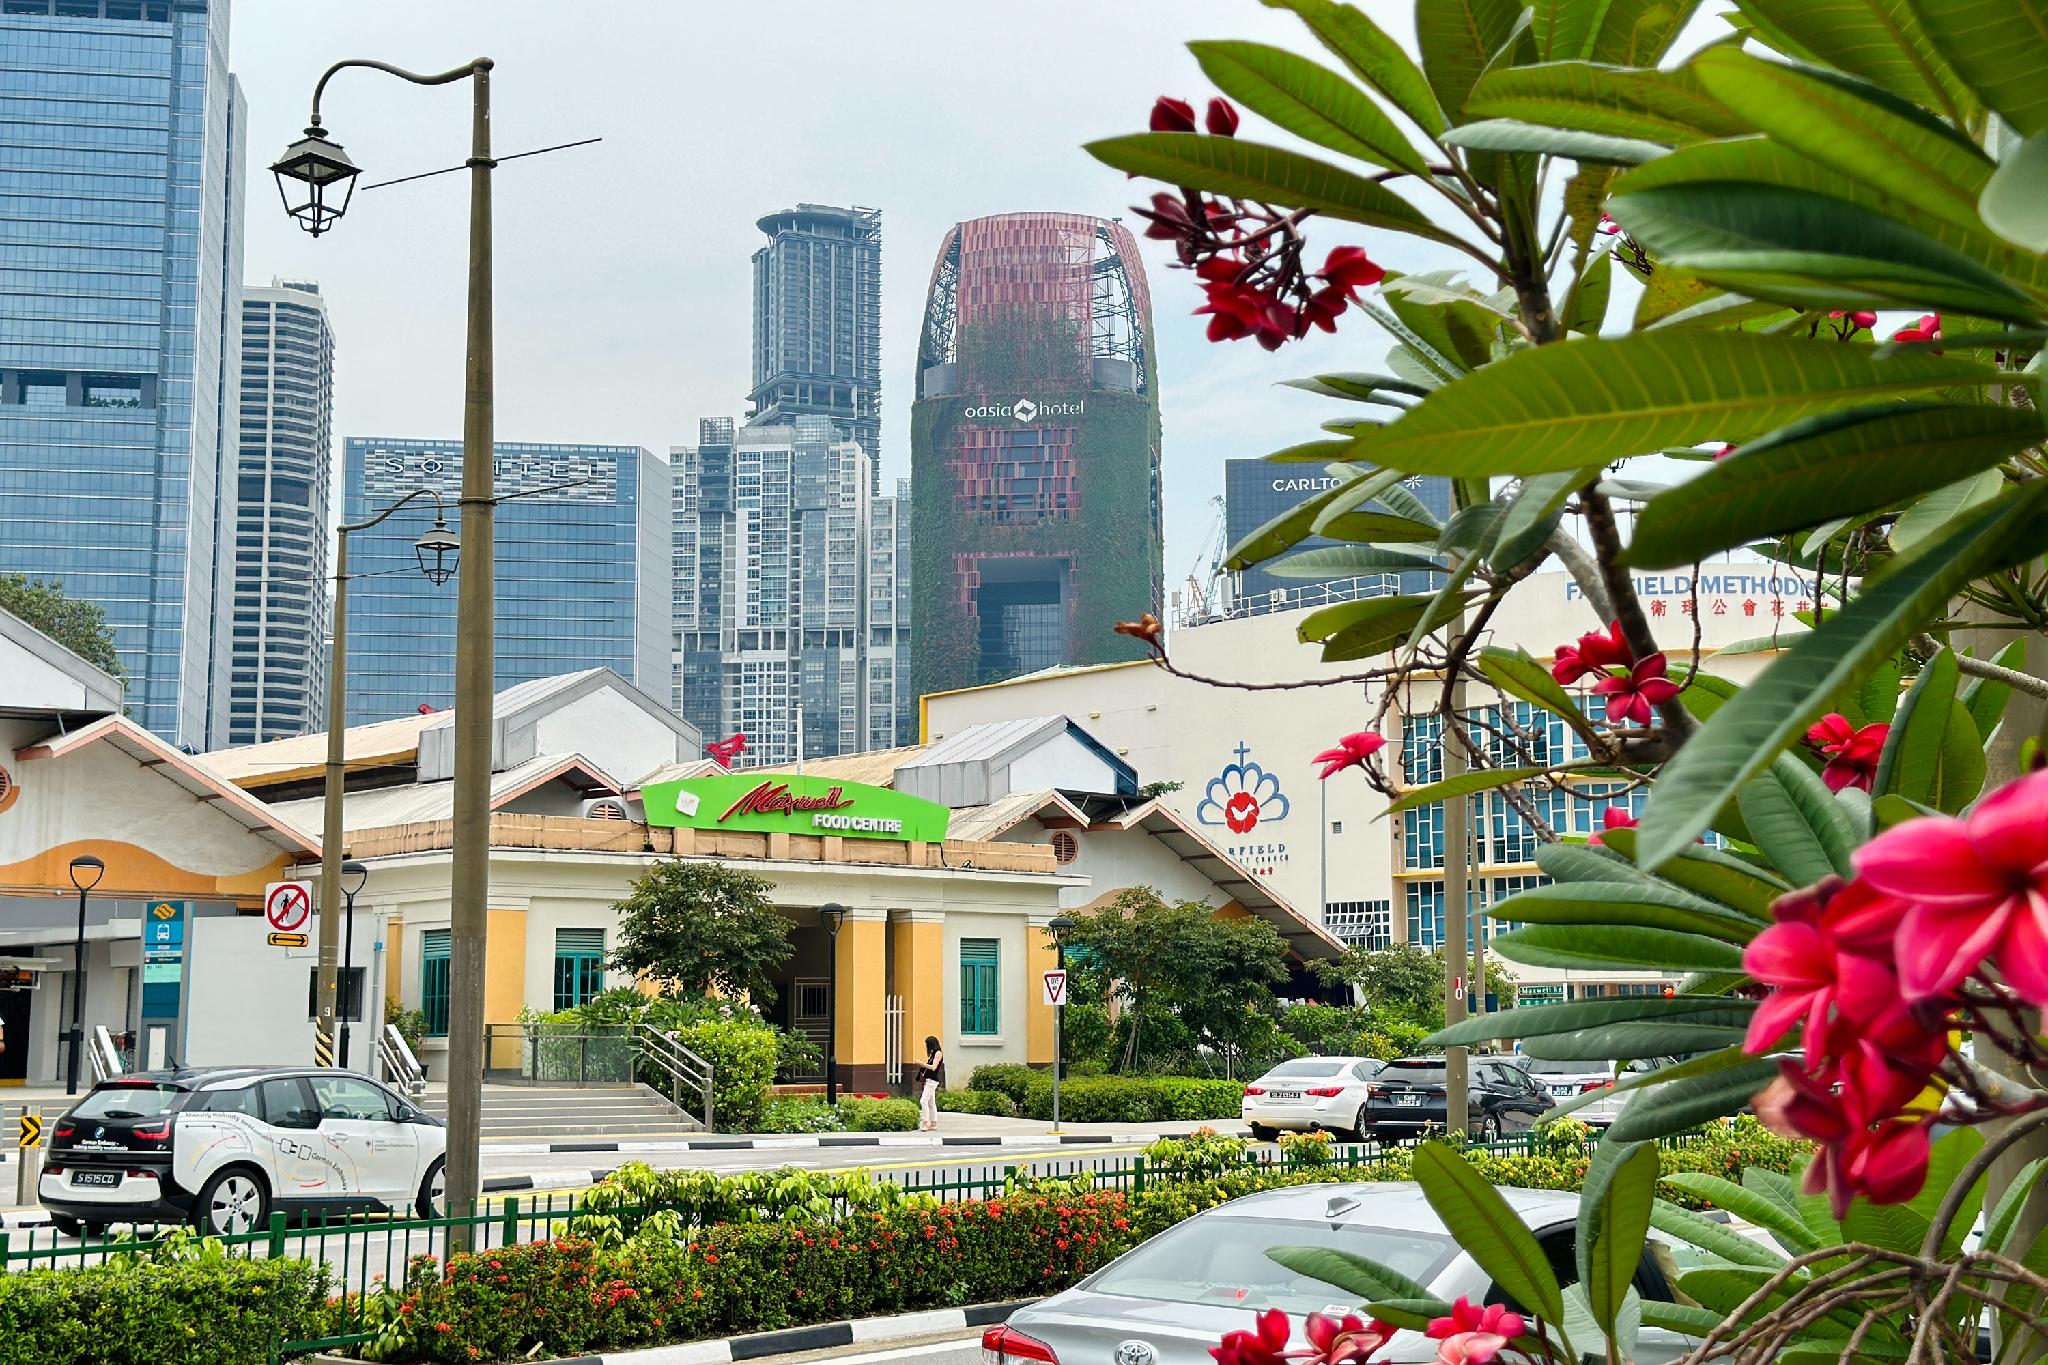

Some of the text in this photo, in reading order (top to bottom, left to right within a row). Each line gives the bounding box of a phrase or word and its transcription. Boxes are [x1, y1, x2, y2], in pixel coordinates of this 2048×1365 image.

[964, 400, 1084, 418] oasia hotel
[385, 457, 603, 479] SOITEL
[717, 780, 854, 822] Maxwell
[812, 814, 902, 833] FOOD CENTRE
[77, 1173, 115, 1184] S1515CD
